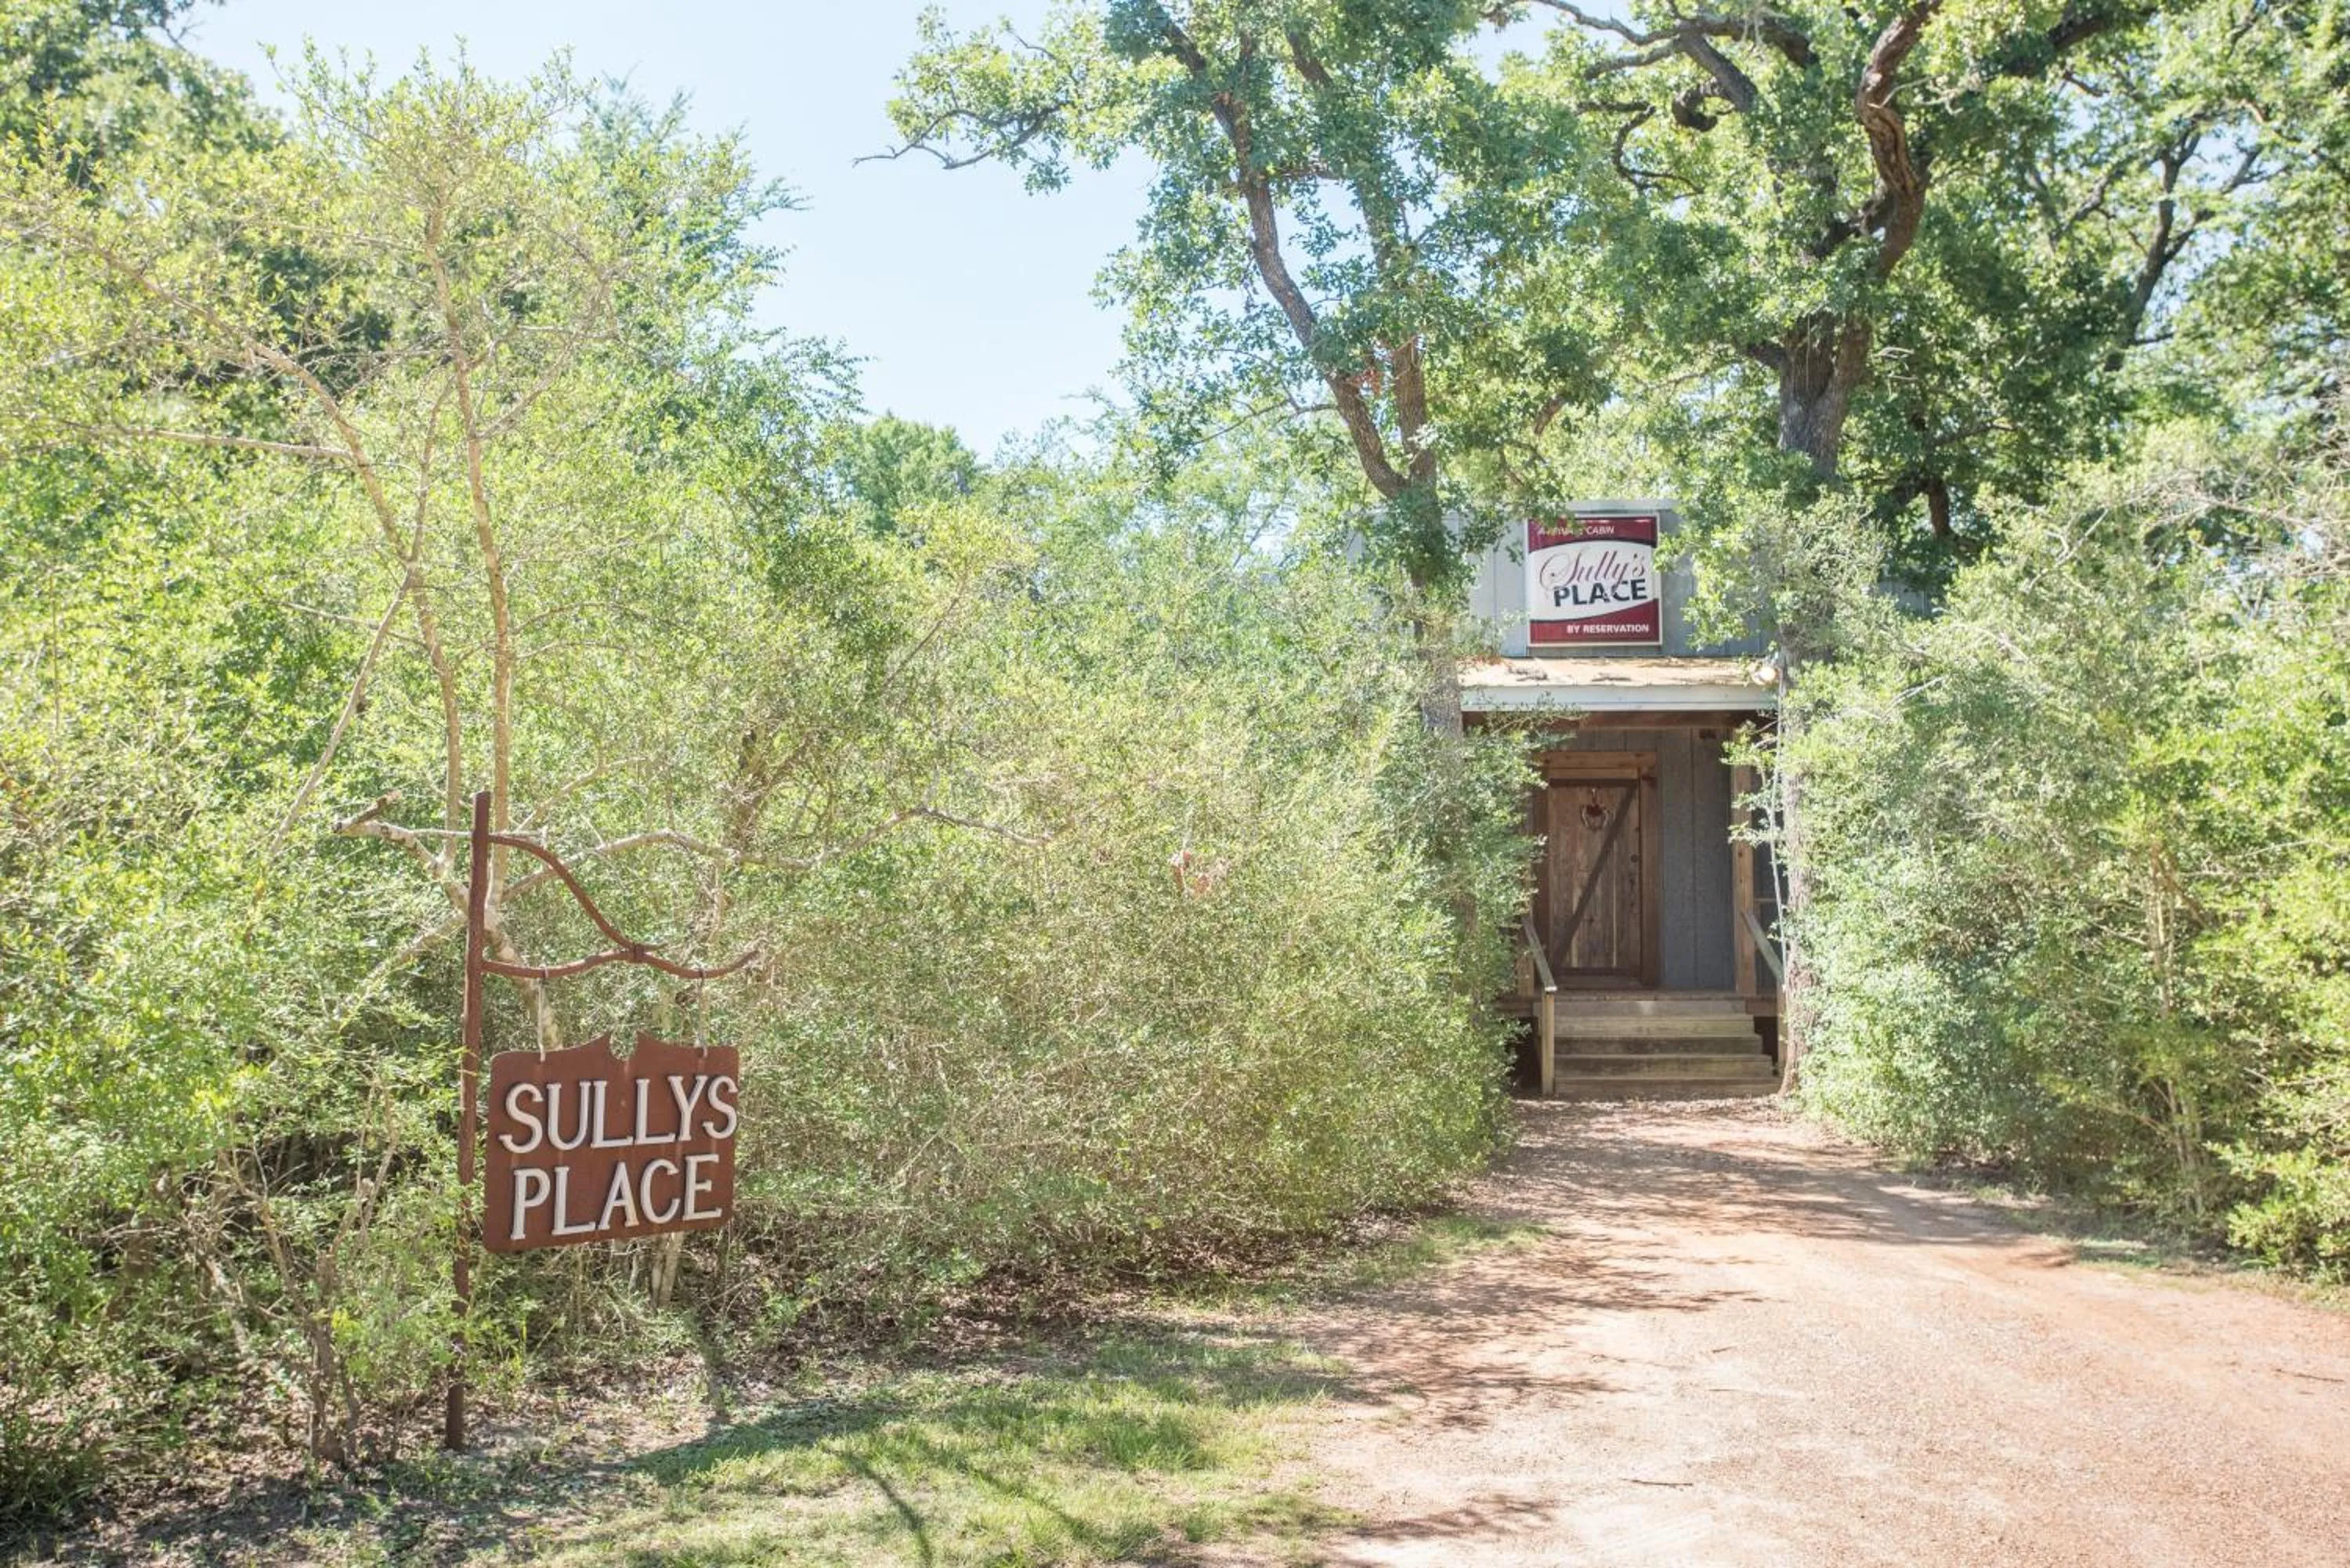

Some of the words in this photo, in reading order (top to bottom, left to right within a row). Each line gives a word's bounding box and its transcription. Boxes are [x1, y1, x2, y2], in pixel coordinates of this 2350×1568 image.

[1585, 526, 1615, 535] CABIN
[1539, 549, 1645, 594] Sully's
[1554, 579, 1647, 607] PLACE
[1567, 624, 1580, 634] BY
[1583, 624, 1649, 634] RESERVATION
[499, 1075, 739, 1154] SULLYS
[511, 1154, 723, 1240] PLACE
